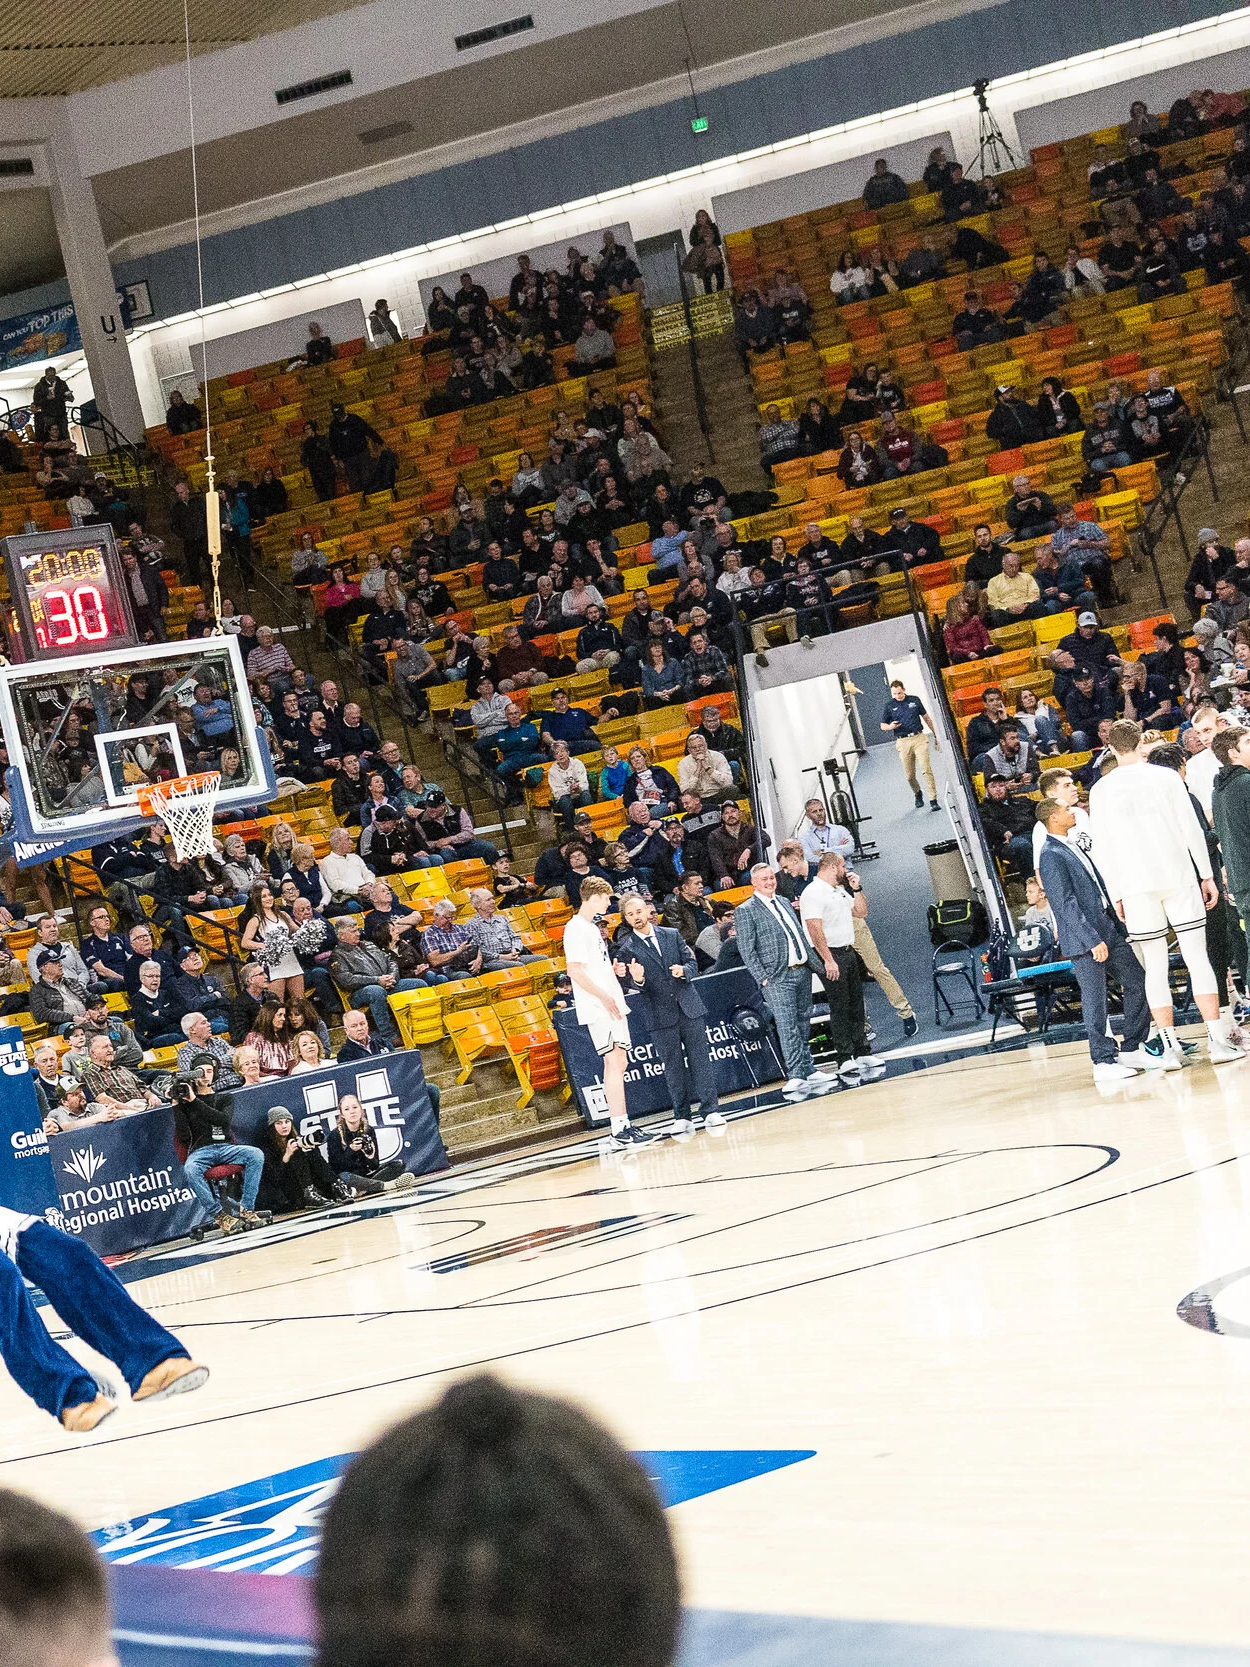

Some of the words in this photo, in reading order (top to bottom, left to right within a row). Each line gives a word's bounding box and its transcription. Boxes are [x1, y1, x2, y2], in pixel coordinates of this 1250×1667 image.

[27, 316, 50, 334] TOP
[50, 303, 74, 323] THIS
[100, 315, 116, 334] U
[28, 547, 104, 586] 20:00
[43, 584, 109, 646] 30
[299, 1097, 406, 1140] STTE
[59, 1167, 171, 1211] mountain
[62, 1201, 125, 1234] egional
